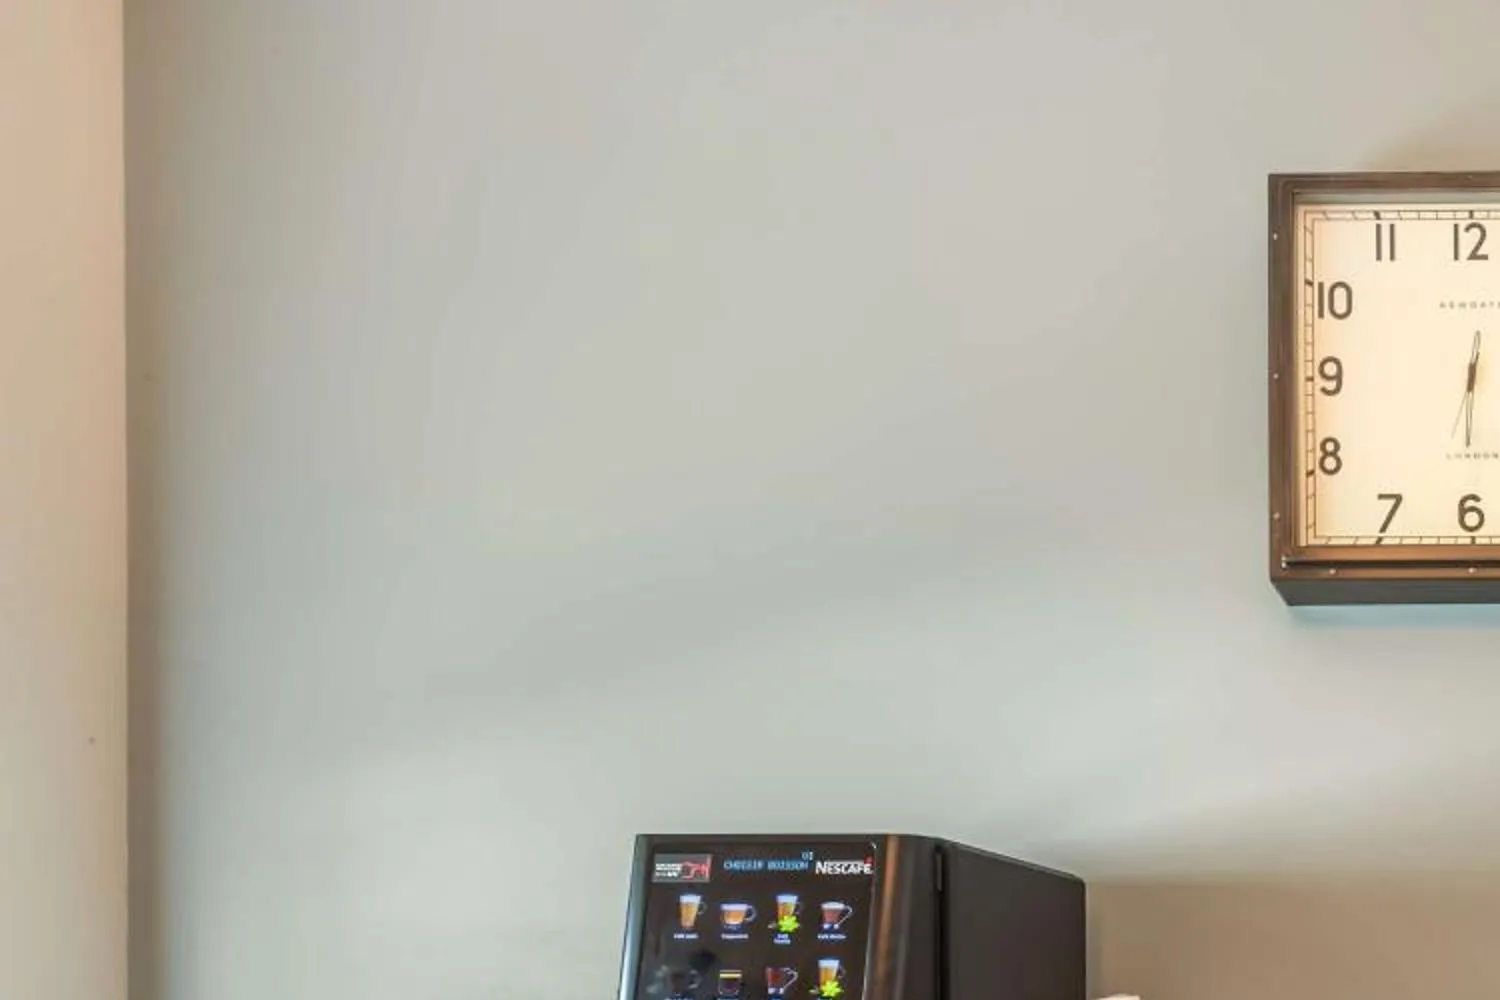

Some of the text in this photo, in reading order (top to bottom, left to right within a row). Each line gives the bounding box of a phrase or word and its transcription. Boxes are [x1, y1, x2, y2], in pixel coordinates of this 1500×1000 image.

[1375, 223, 1396, 262] 11
[1453, 222, 1489, 262] 12
[1318, 281, 1353, 320] 10
[1318, 355, 1343, 397] 9
[1318, 437, 1342, 476] 8
[1377, 493, 1403, 534] 7
[1457, 493, 1485, 533] 6
